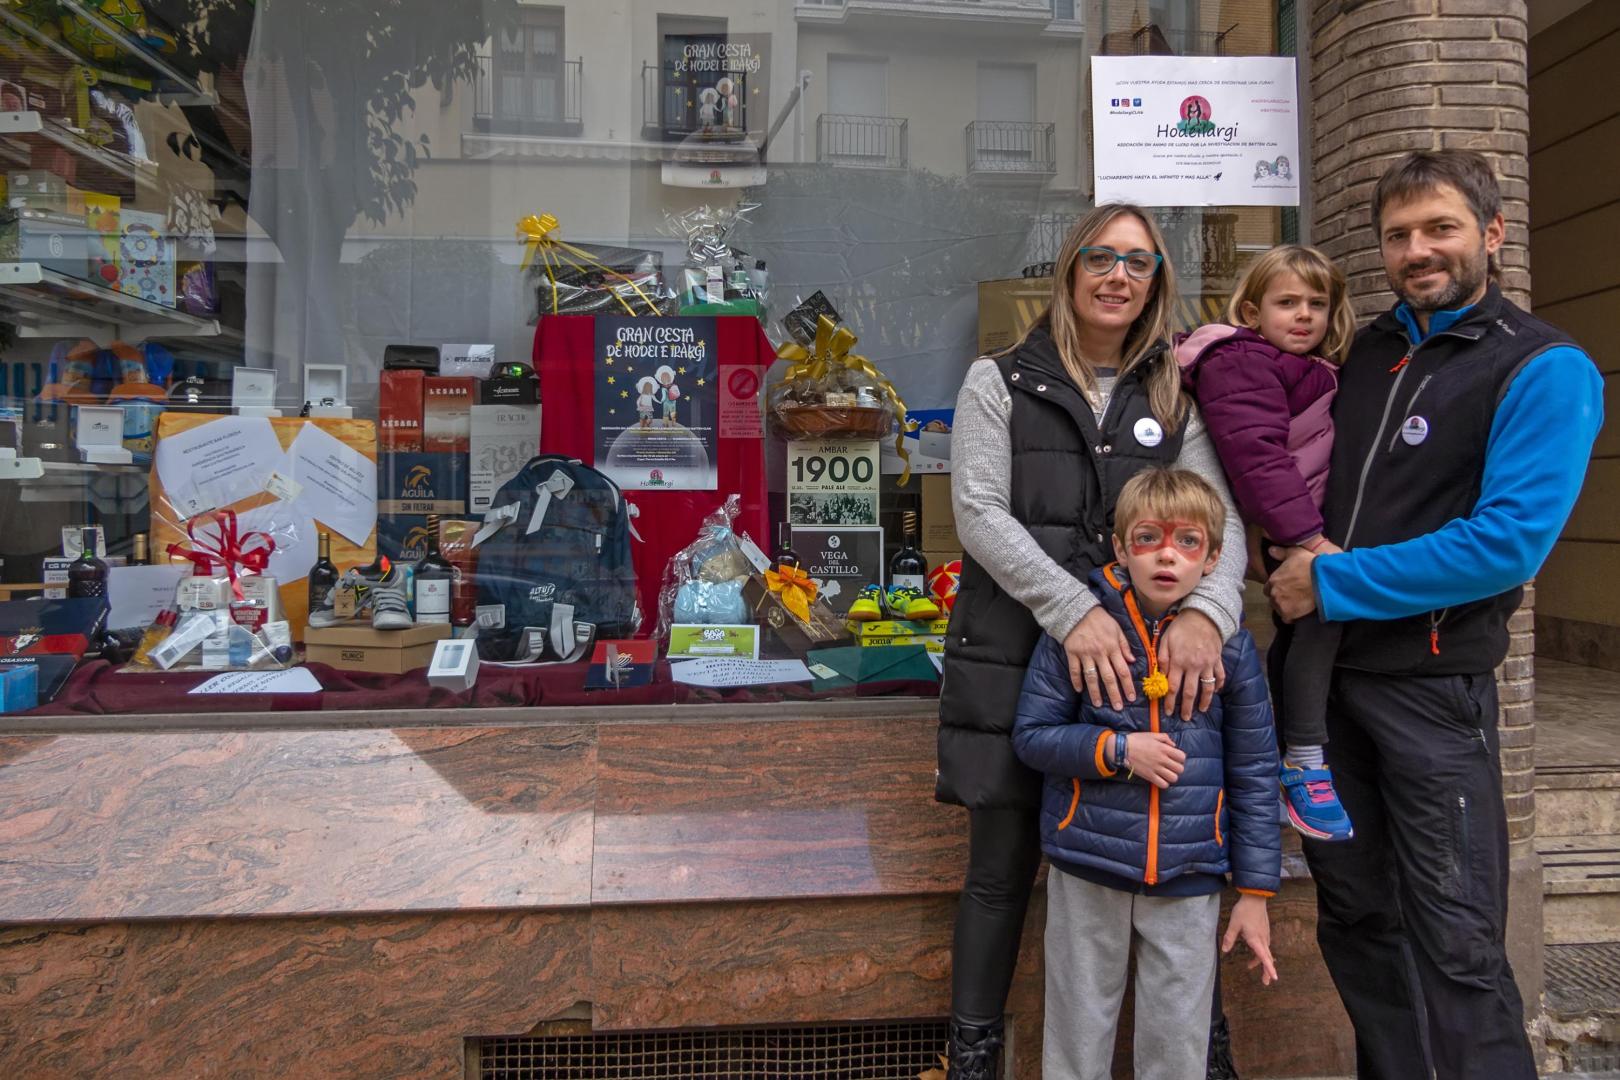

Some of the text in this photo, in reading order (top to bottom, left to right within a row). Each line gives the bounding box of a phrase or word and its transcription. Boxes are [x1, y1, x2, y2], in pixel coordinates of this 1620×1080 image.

[684, 43, 751, 59] GRAN CESTA
[674, 60, 688, 71] DE
[690, 60, 719, 72] HODEI
[722, 60, 728, 71] E
[1157, 122, 1239, 141] Hodeilargi
[617, 327, 694, 343] GRAN CESTA
[606, 345, 622, 358] DE
[624, 345, 658, 358] HODEI
[661, 345, 668, 358] E
[791, 455, 874, 483] 1900
[401, 503, 412, 511] SIN
[820, 551, 848, 560] VEGA
[809, 565, 859, 574] CASTILLO
